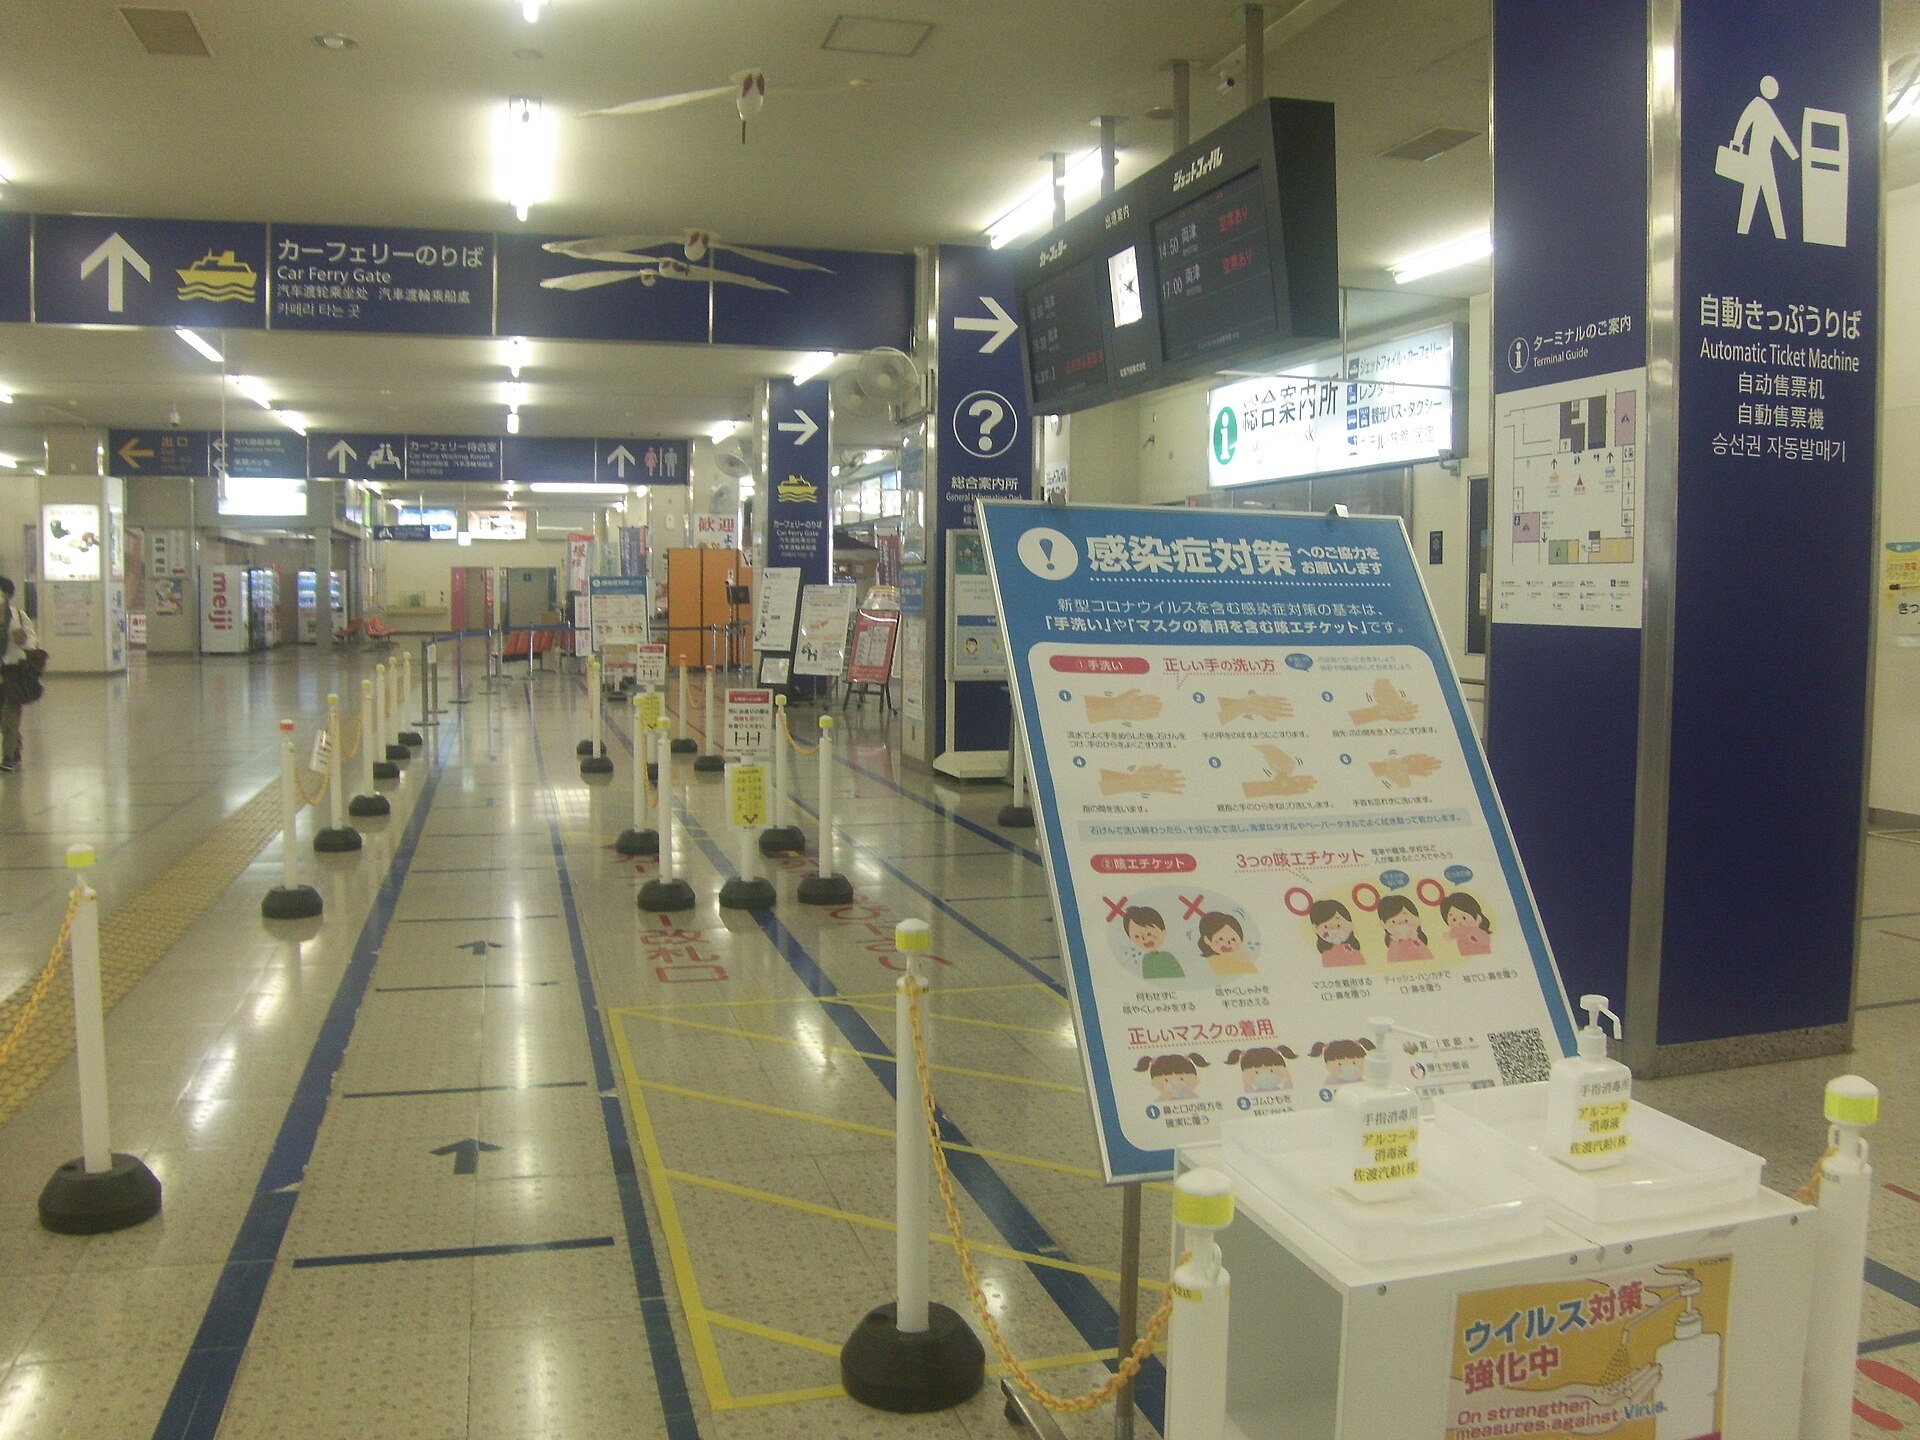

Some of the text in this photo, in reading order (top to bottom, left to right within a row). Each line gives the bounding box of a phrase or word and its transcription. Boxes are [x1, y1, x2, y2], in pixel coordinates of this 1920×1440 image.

[1172, 146, 1224, 192] ジェットフォイル
[277, 238, 485, 269] カーフェリーのりば
[276, 265, 393, 287] Car Ferry Gate
[1699, 293, 1862, 340] 自動きっぷうりば
[1532, 314, 1632, 352] ターミナルのご案内
[1532, 346, 1589, 368] Terminal Guide
[1699, 337, 1860, 373] Automatic Ticket Machine
[1737, 371, 1826, 400] 自动售票机
[1737, 402, 1825, 431] 自動售票機
[1711, 432, 1847, 463] 승선권 자동발매기
[945, 491, 971, 502] General
[951, 475, 1019, 491] 総合案内所
[1085, 534, 1380, 577] 感染症対策 へのご協力を
[1300, 559, 1383, 577] お願いします
[209, 572, 233, 631] meiji
[1164, 656, 1276, 673] 正しい手の洗い方
[1128, 1018, 1275, 1046] 正しいマスクの着用
[1360, 1105, 1418, 1127] 手指消毒用
[1578, 1101, 1628, 1120] アルコール
[1362, 1128, 1416, 1147] アルコール
[1589, 1117, 1620, 1133] 消毒液
[1374, 1144, 1408, 1162] 消毒液
[1464, 1281, 1643, 1354] ウイルス対策
[1463, 1344, 1560, 1395] 強化中
[1456, 1420, 1546, 1440] measures
[1552, 1409, 1618, 1430] against
[1457, 1400, 1590, 1426] On strengthen
